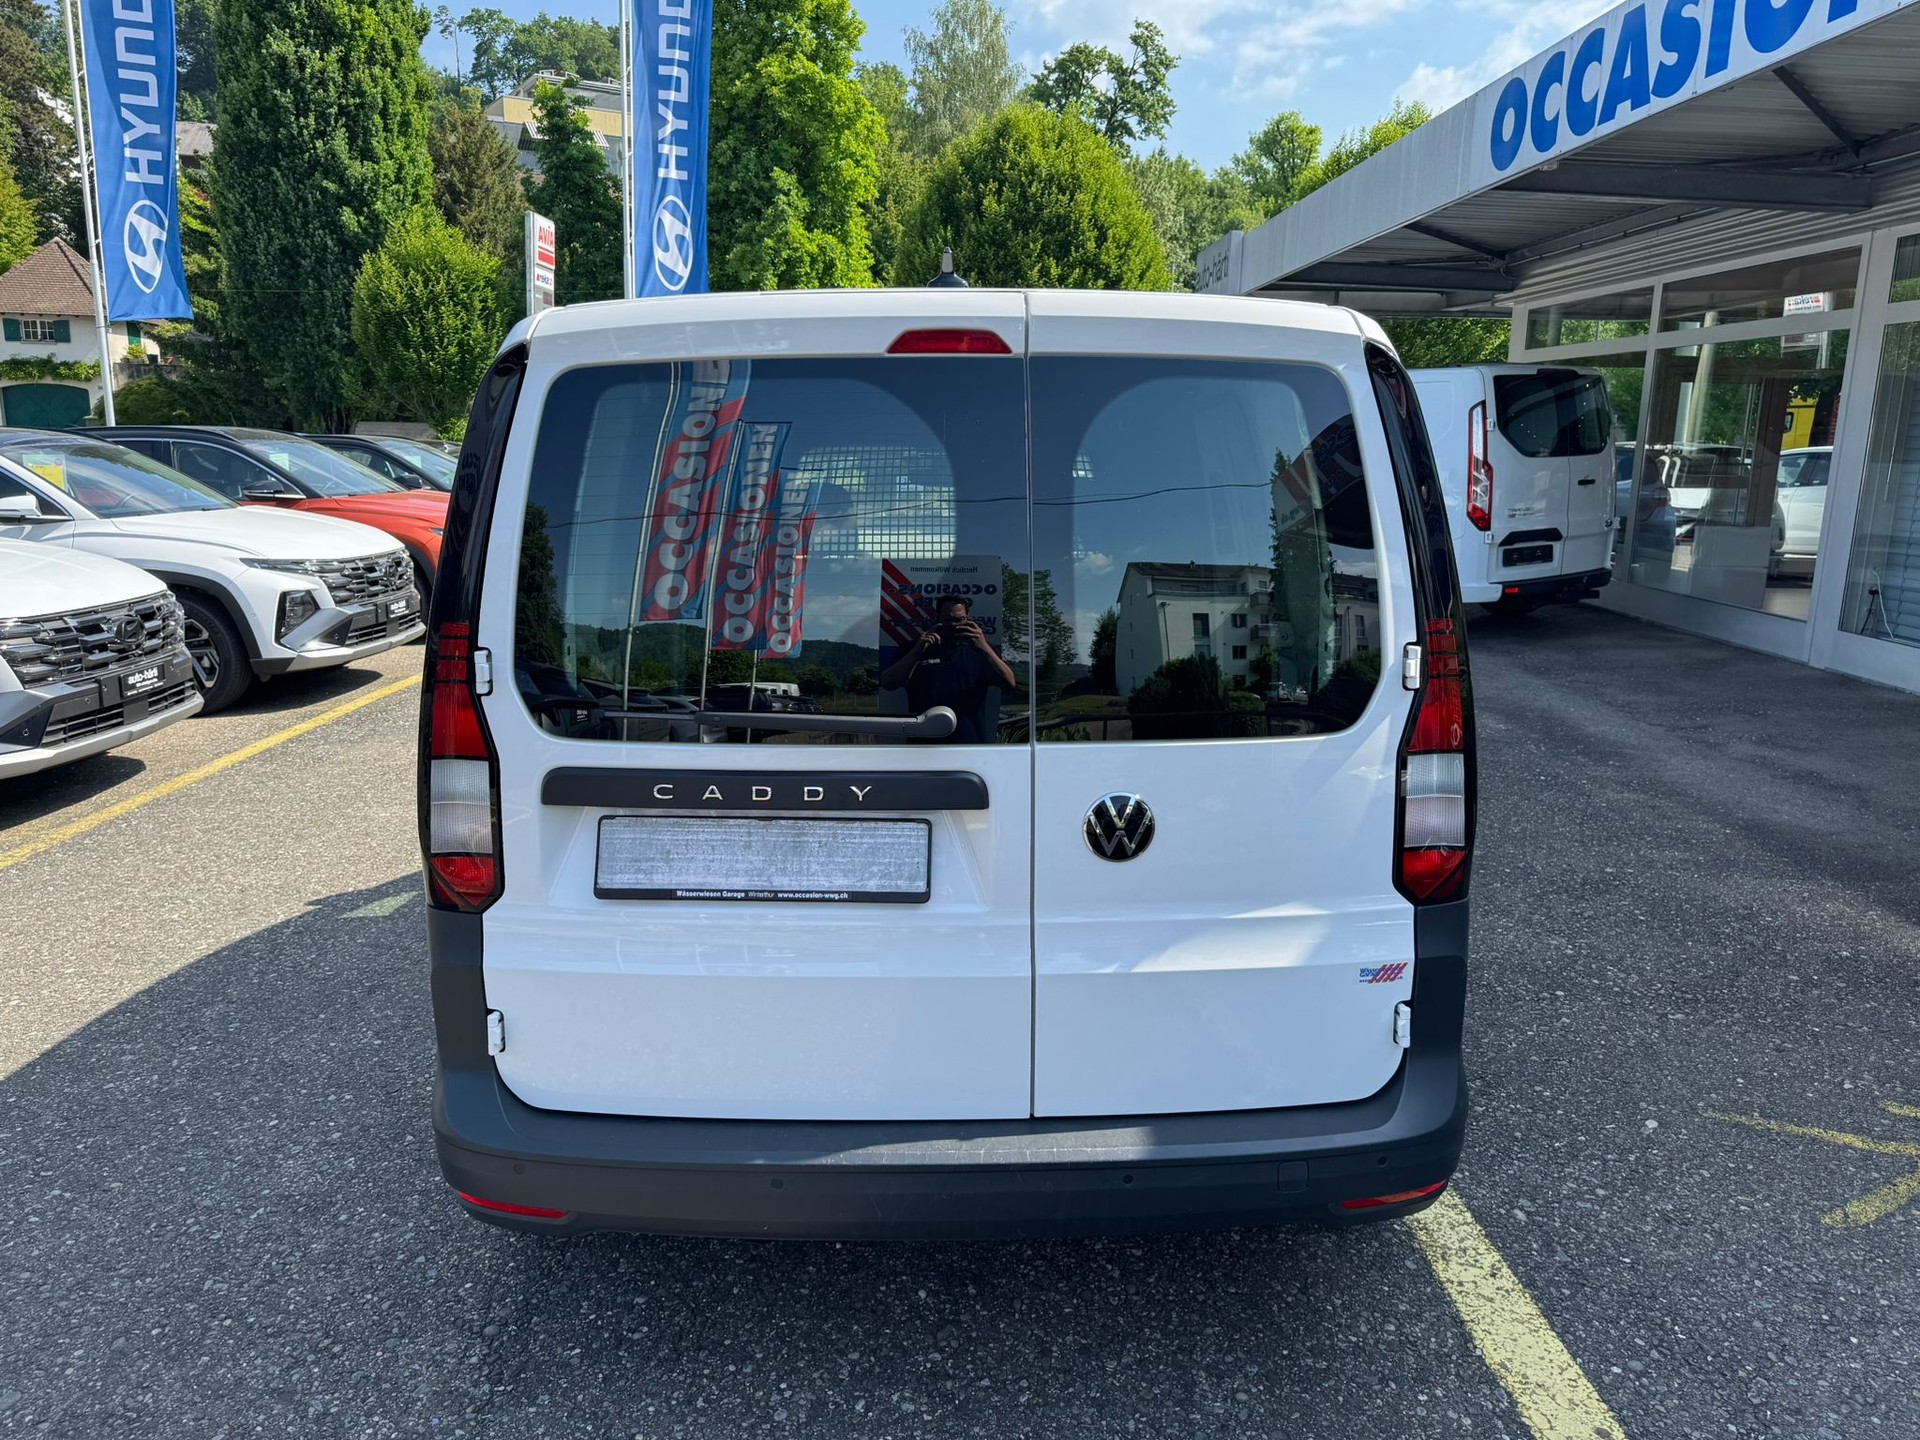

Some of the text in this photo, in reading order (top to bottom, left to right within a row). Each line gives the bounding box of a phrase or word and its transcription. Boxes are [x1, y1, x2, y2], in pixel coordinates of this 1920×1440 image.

[1490, 0, 1858, 171] OCCASIO
[653, 783, 872, 801] CADDY
[722, 891, 745, 899] Garage
[777, 891, 848, 900] www.occasion-wwg.ch
